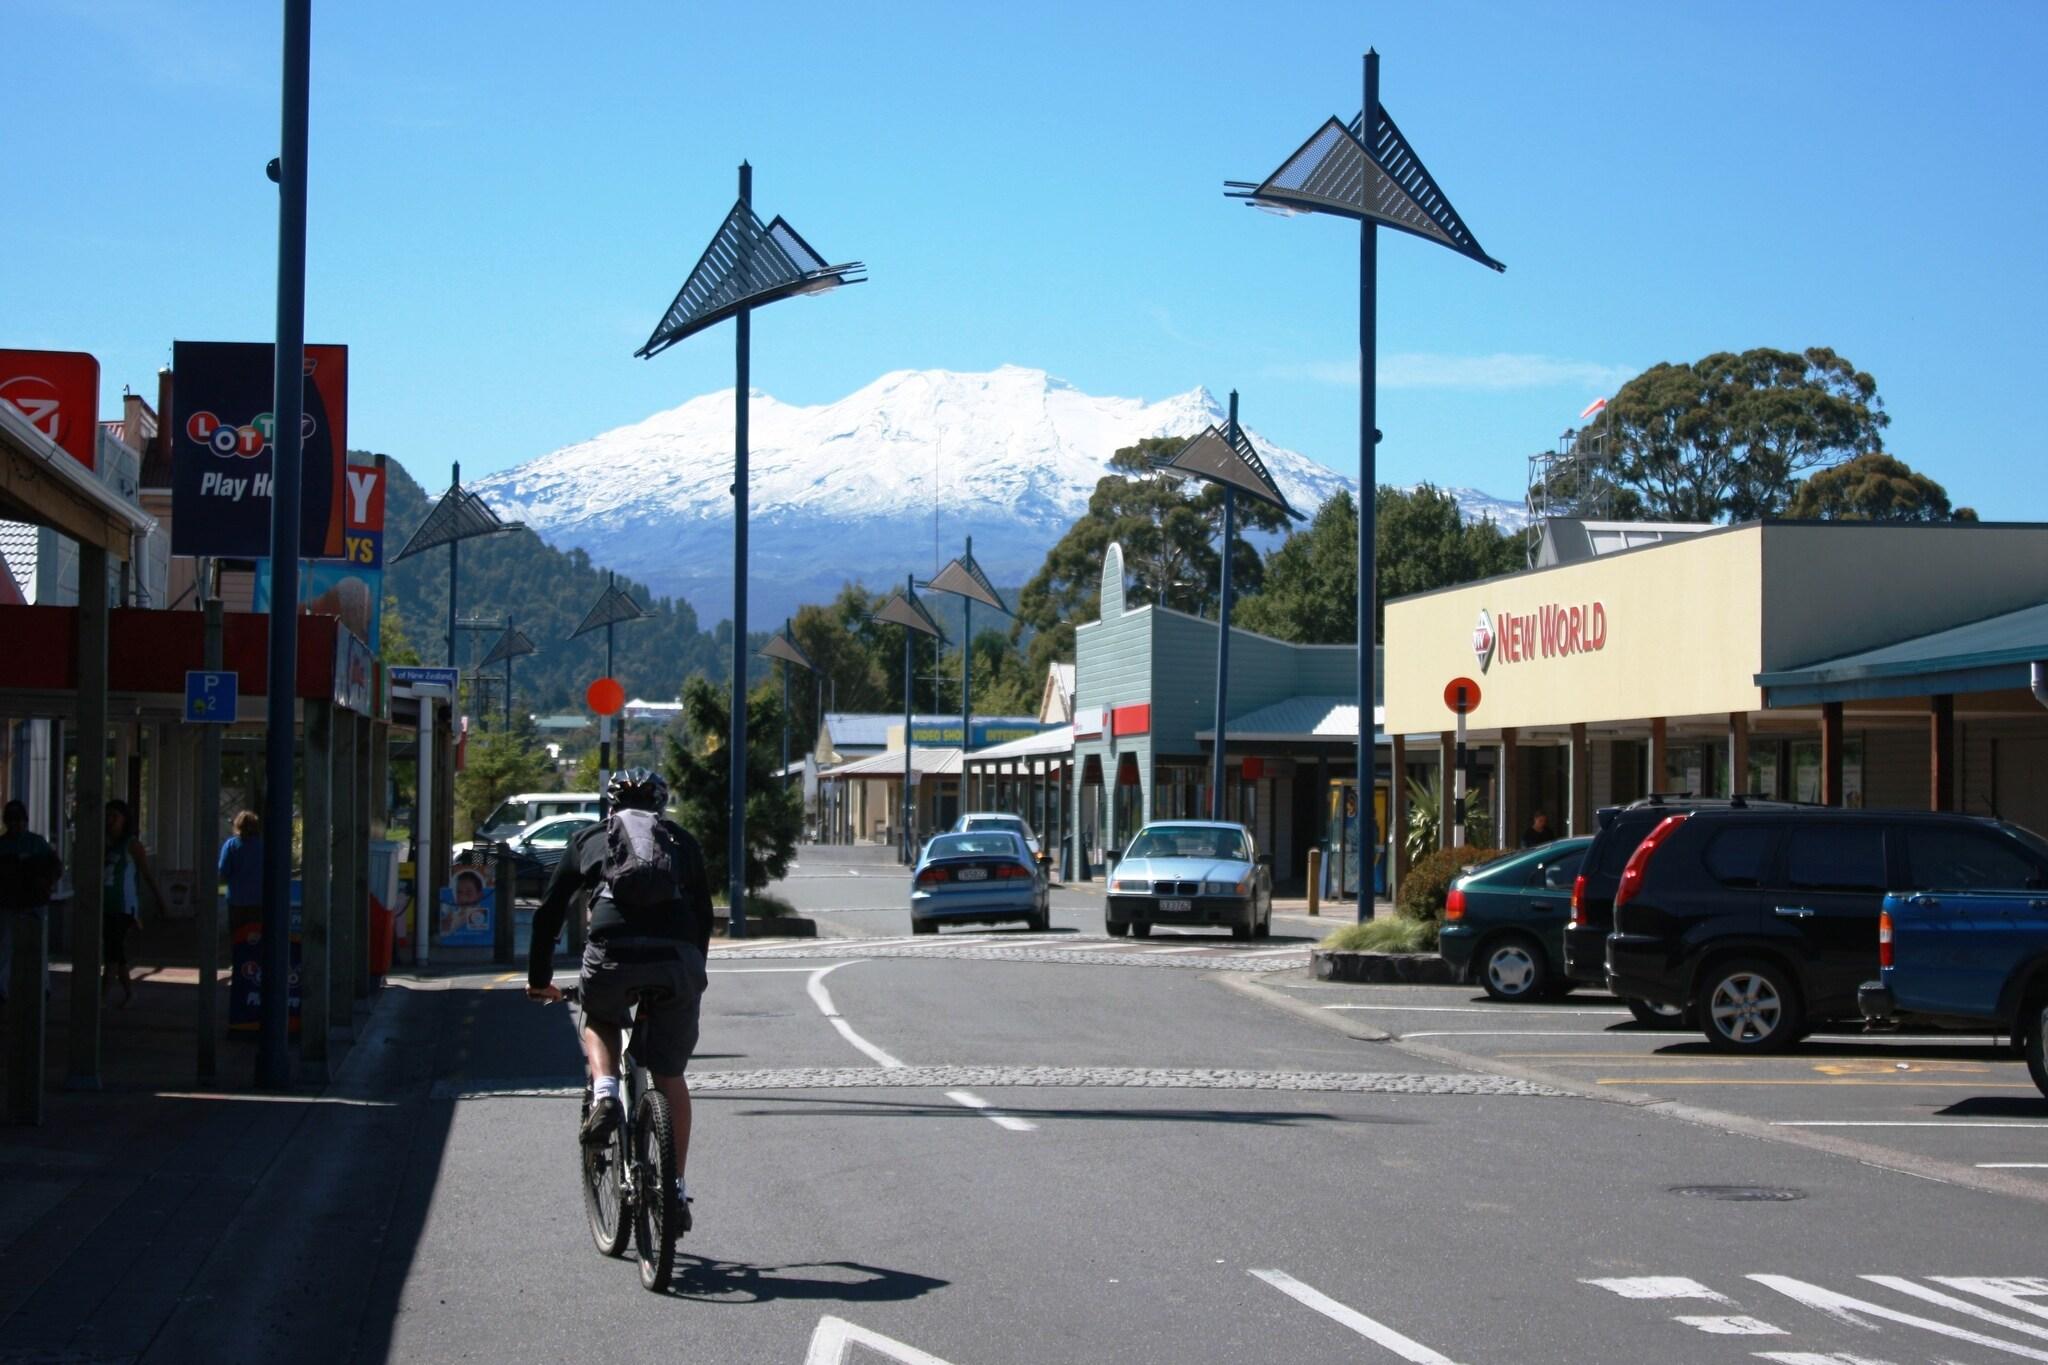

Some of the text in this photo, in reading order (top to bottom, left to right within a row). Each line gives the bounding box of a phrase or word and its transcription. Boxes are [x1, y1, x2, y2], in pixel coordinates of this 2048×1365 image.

[198, 417, 274, 451] LOTT
[200, 472, 247, 502] Play
[347, 471, 377, 523] Y
[1497, 602, 1607, 665] NEW WORLD
[204, 675, 219, 693] P
[407, 671, 423, 680] New
[425, 671, 453, 681] Zealand
[207, 696, 216, 710] 2
[911, 728, 963, 742] VIDEO SHO
